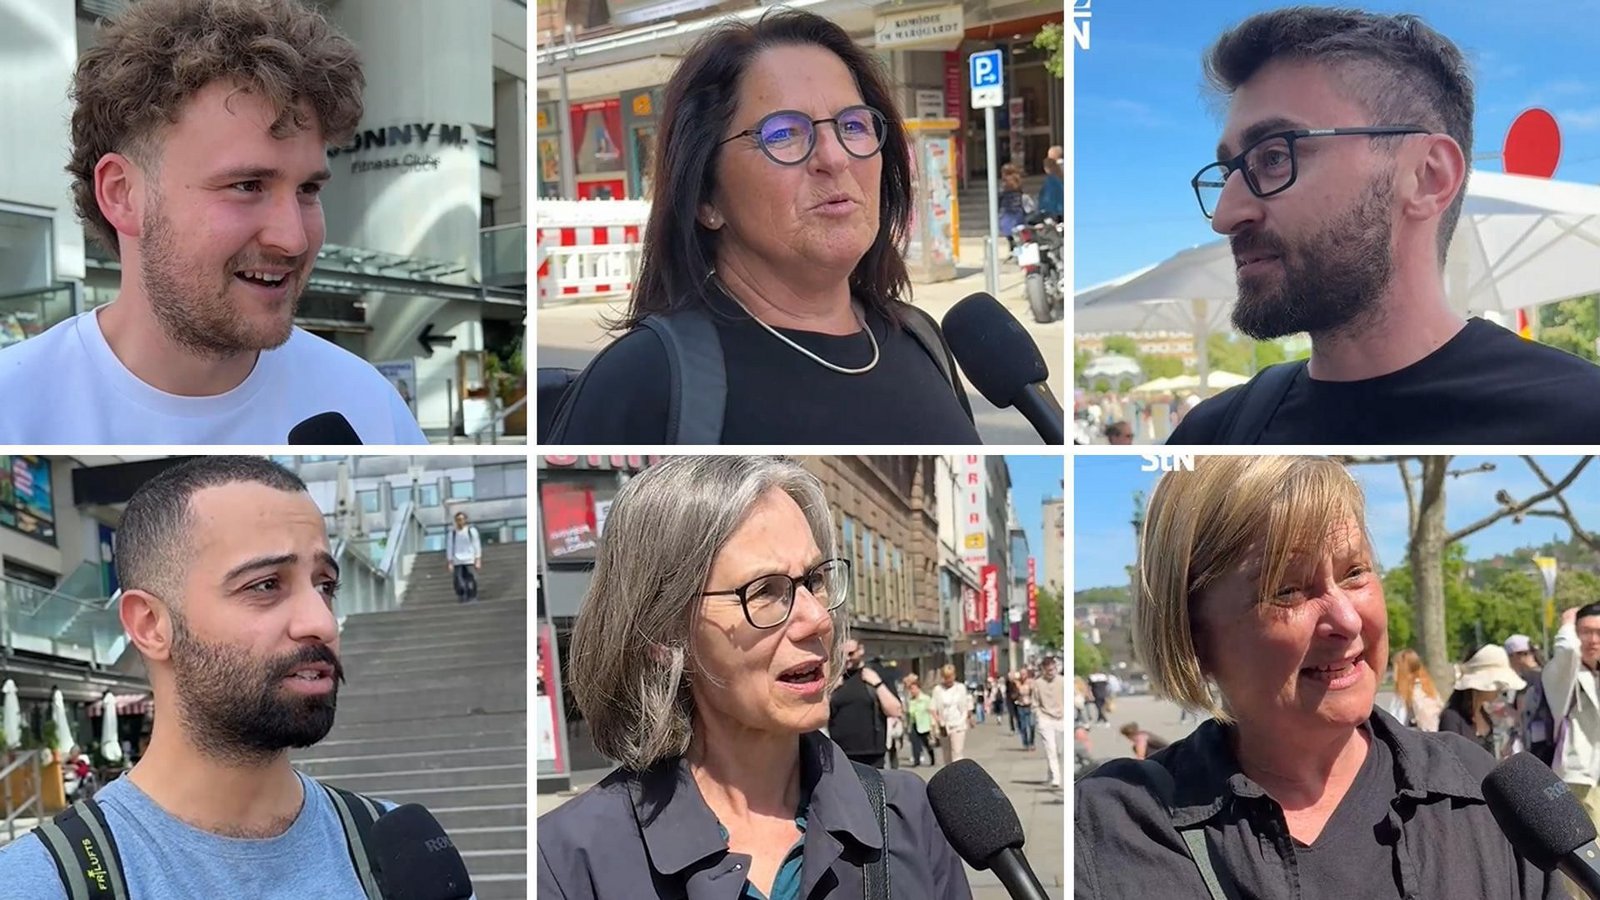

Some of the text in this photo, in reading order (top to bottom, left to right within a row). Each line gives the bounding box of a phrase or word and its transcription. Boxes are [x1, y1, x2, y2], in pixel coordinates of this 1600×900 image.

[975, 57, 993, 84] P
[327, 123, 434, 157] ONNY
[81, 838, 107, 890] FRILUFTS
